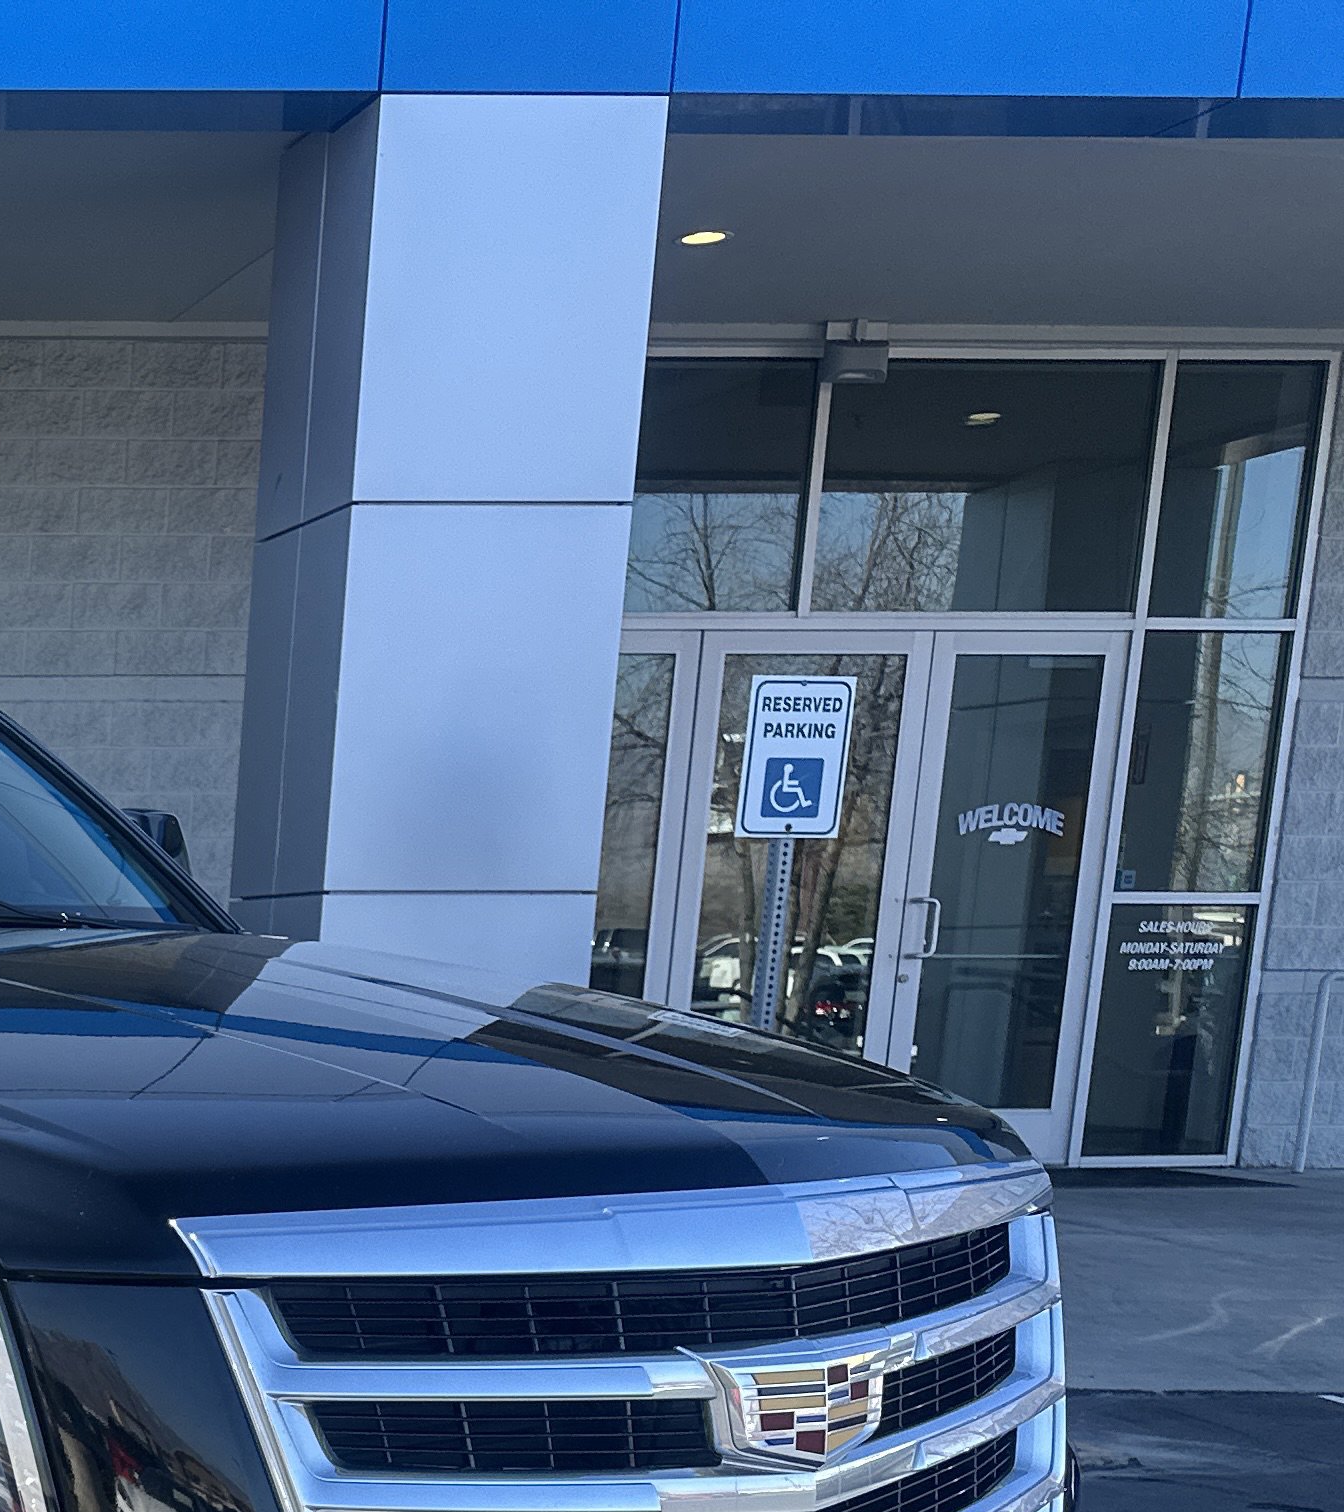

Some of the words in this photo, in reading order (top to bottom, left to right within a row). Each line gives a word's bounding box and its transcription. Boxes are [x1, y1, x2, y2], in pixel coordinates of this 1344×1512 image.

[762, 696, 843, 713] RESERVED
[763, 722, 837, 739] PARKING
[958, 802, 1065, 837] WELCOME
